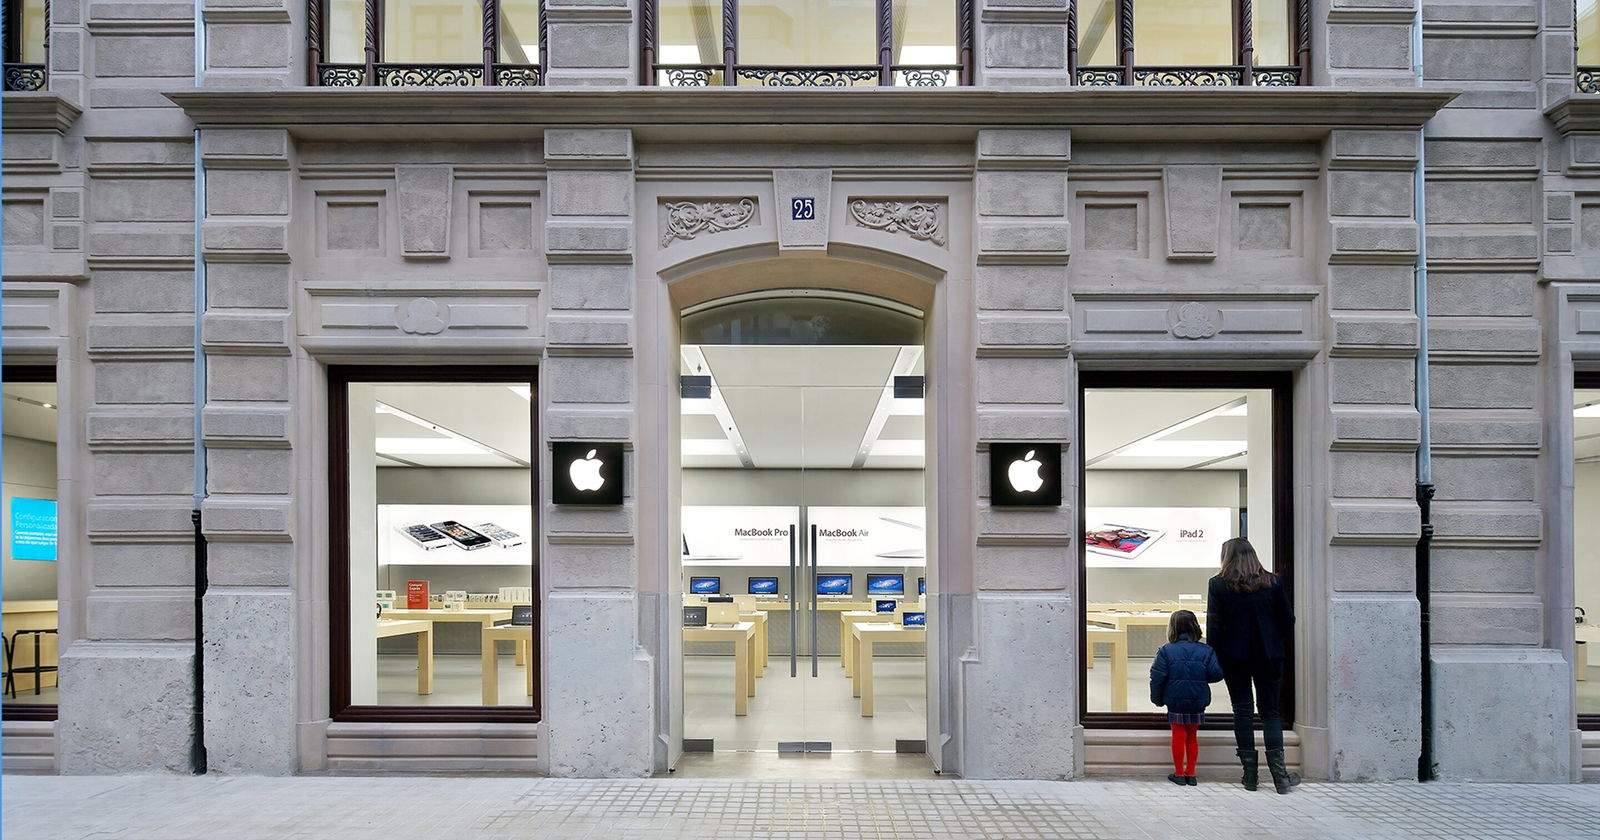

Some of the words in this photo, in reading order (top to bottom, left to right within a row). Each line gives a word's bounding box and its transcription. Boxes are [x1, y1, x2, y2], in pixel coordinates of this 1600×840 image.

[794, 199, 813, 218] 25
[734, 528, 773, 537] MacBook
[774, 528, 789, 537] Pro
[819, 528, 857, 537] MacBook
[858, 529, 869, 537] Air
[1180, 529, 1198, 538] iPad
[1198, 529, 1204, 538] 2
